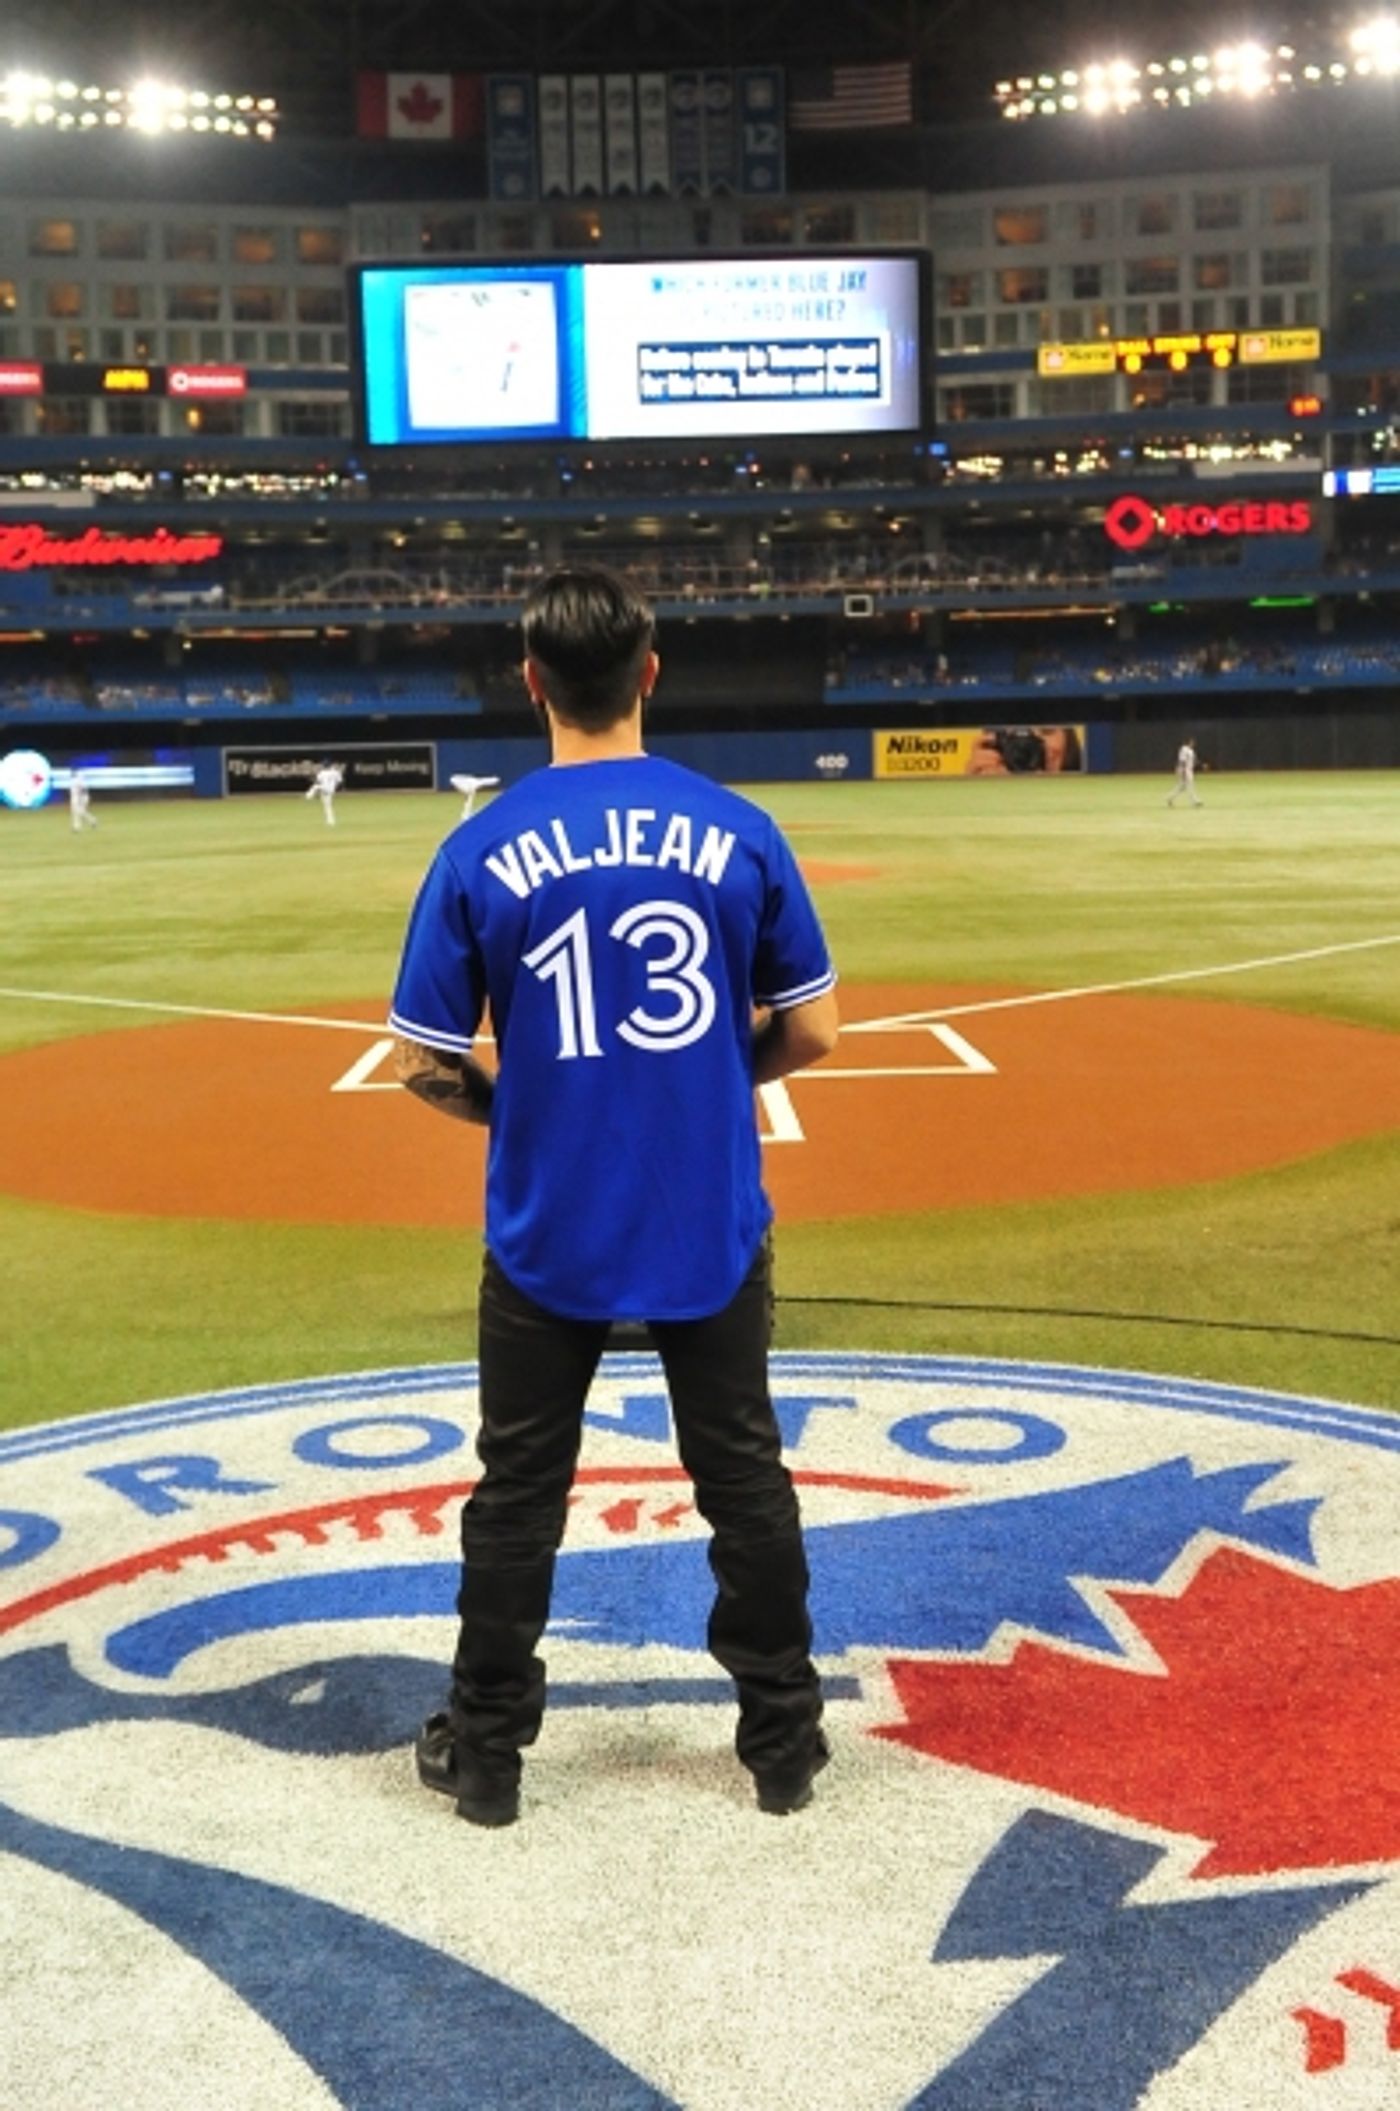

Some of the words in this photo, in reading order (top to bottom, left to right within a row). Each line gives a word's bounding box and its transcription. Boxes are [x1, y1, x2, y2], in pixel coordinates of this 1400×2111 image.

[837, 269, 869, 292] JAY
[1164, 501, 1311, 535] ROGERS
[886, 734, 958, 755] Nikon
[815, 753, 849, 769] 400
[485, 809, 736, 899] VALJEAN
[520, 900, 717, 1060] 13
